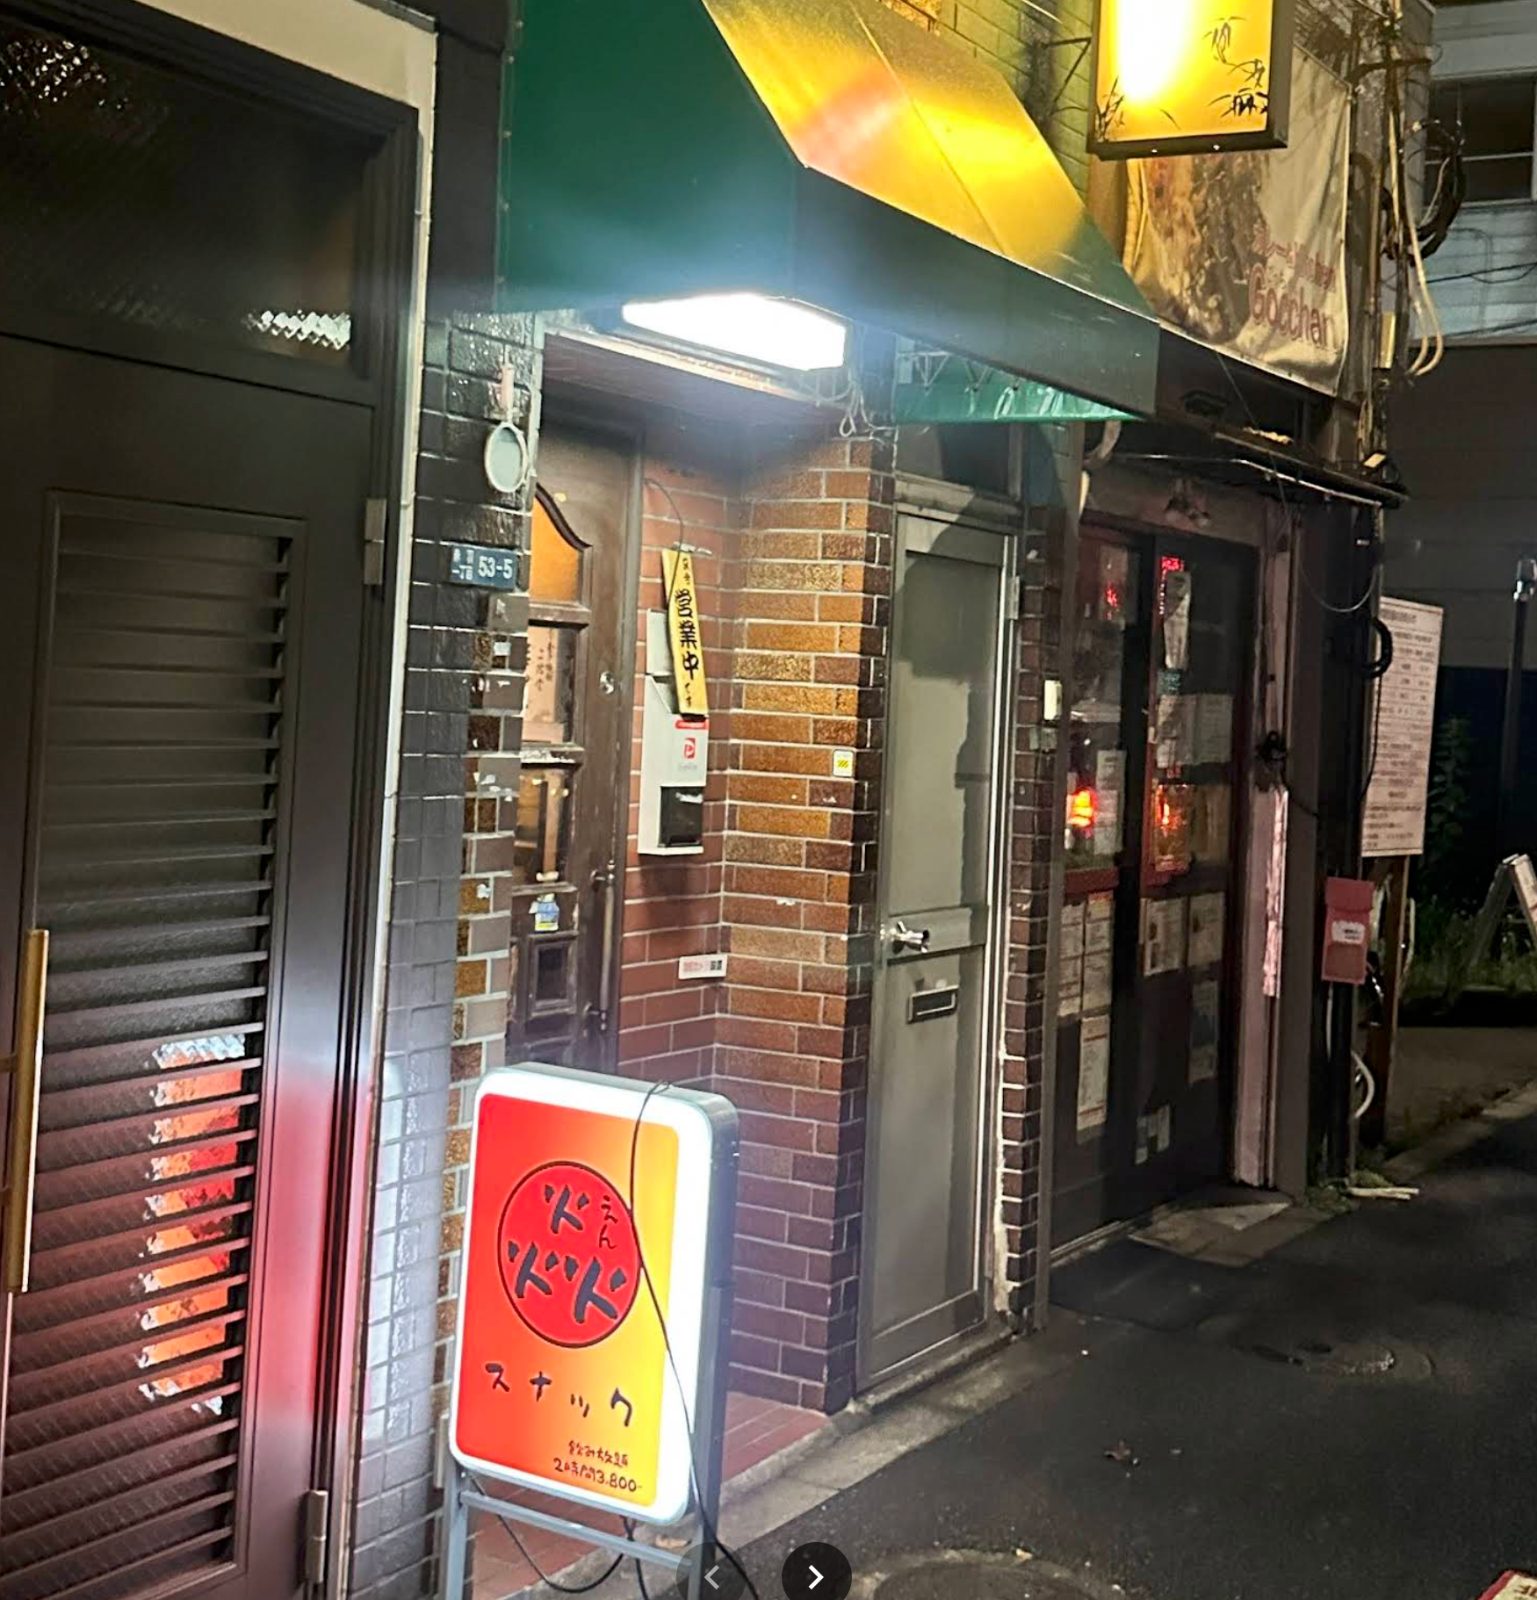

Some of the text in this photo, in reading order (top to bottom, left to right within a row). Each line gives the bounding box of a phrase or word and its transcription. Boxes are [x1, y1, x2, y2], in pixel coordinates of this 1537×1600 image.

[478, 555, 513, 580] 53-5
[600, 1194, 618, 1250] えん
[485, 1362, 633, 1428] スナック
